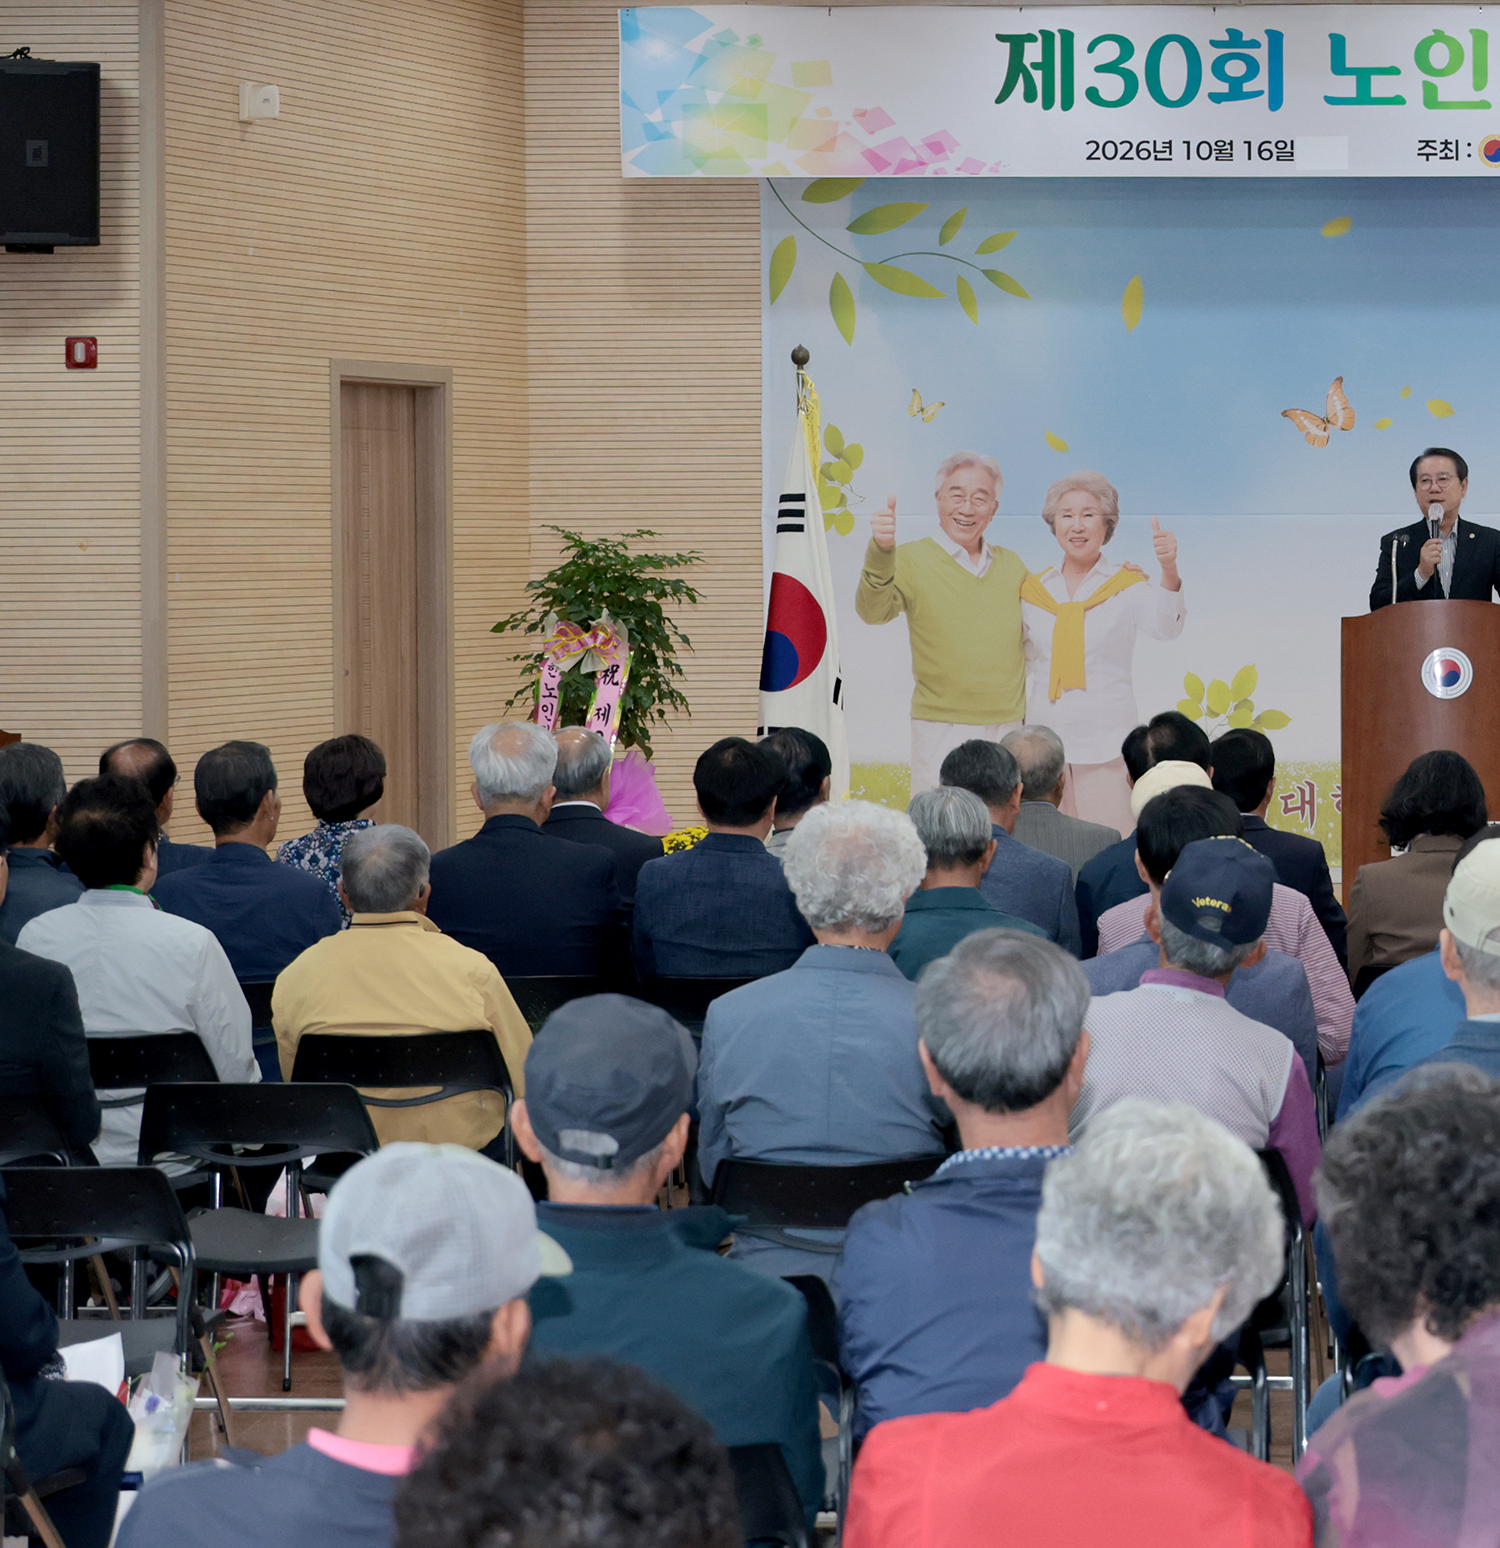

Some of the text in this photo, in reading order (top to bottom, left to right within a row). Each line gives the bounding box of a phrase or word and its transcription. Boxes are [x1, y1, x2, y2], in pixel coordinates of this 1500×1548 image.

[994, 27, 1285, 113] 제30회
[1085, 139, 1296, 162] 2026년 10월 16일
[1416, 138, 1460, 162] 주최
